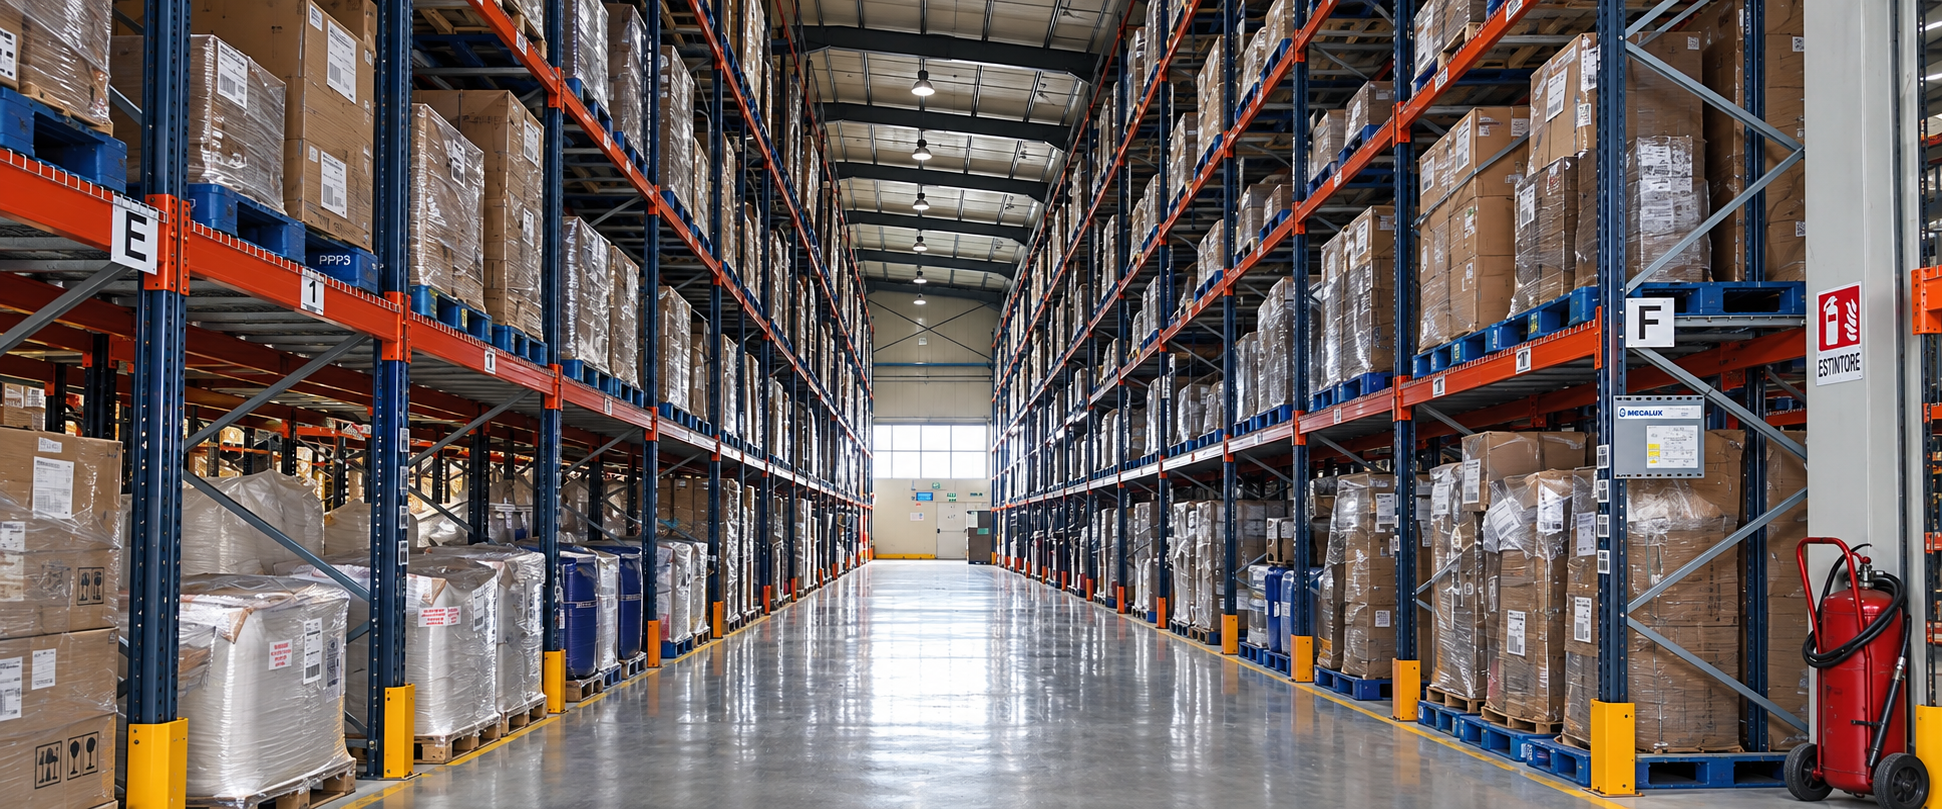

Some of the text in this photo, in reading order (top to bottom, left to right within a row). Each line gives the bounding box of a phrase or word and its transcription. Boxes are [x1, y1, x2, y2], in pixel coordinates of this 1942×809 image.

[125, 210, 147, 262] E
[309, 280, 316, 303] 1
[1639, 305, 1661, 340] F
[1818, 352, 1861, 378] ESTINTORE
[1627, 409, 1663, 417] MECALUX
